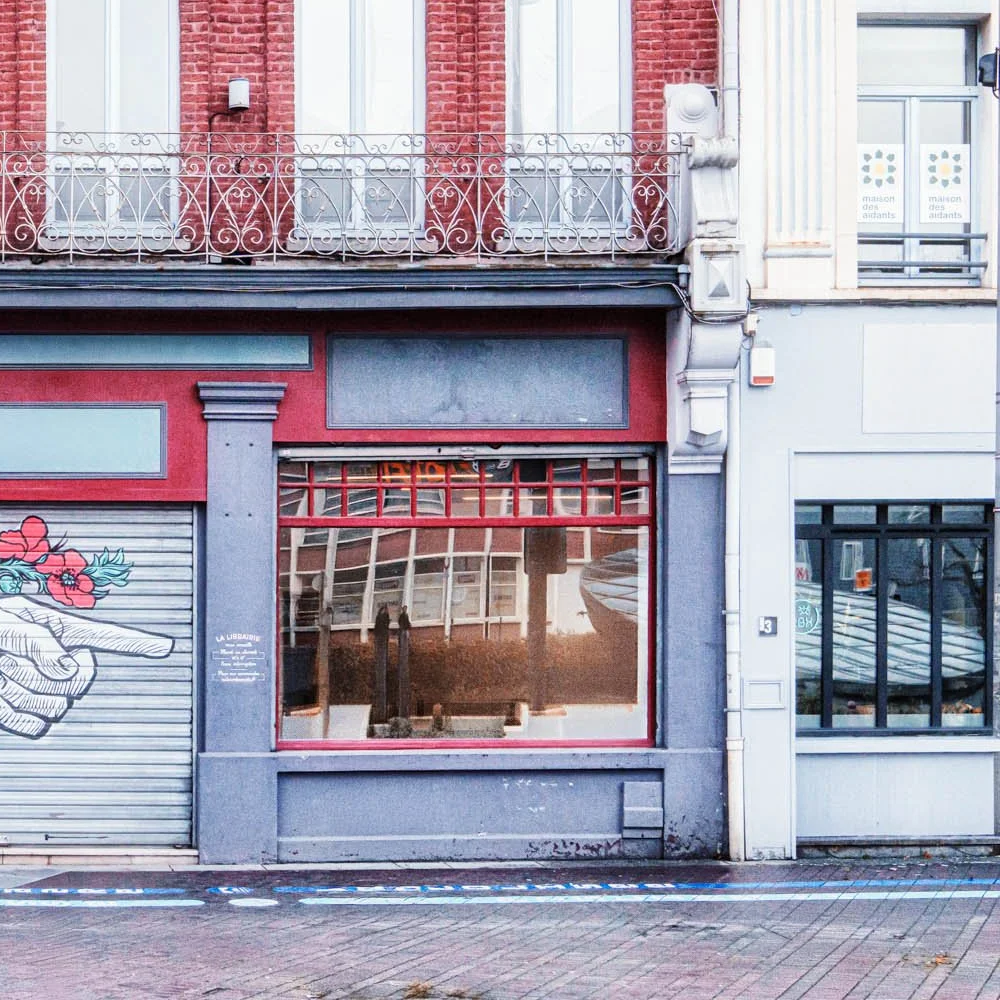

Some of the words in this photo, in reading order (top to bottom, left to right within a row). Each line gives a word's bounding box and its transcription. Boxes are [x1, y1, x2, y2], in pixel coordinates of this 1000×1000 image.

[862, 195, 895, 203] maison
[928, 195, 961, 203] maison
[862, 203, 879, 211] des
[928, 203, 945, 211] des
[862, 211, 896, 219] aidants
[928, 211, 962, 219] aidants
[764, 619, 772, 633] 3
[215, 635, 226, 643] LA
